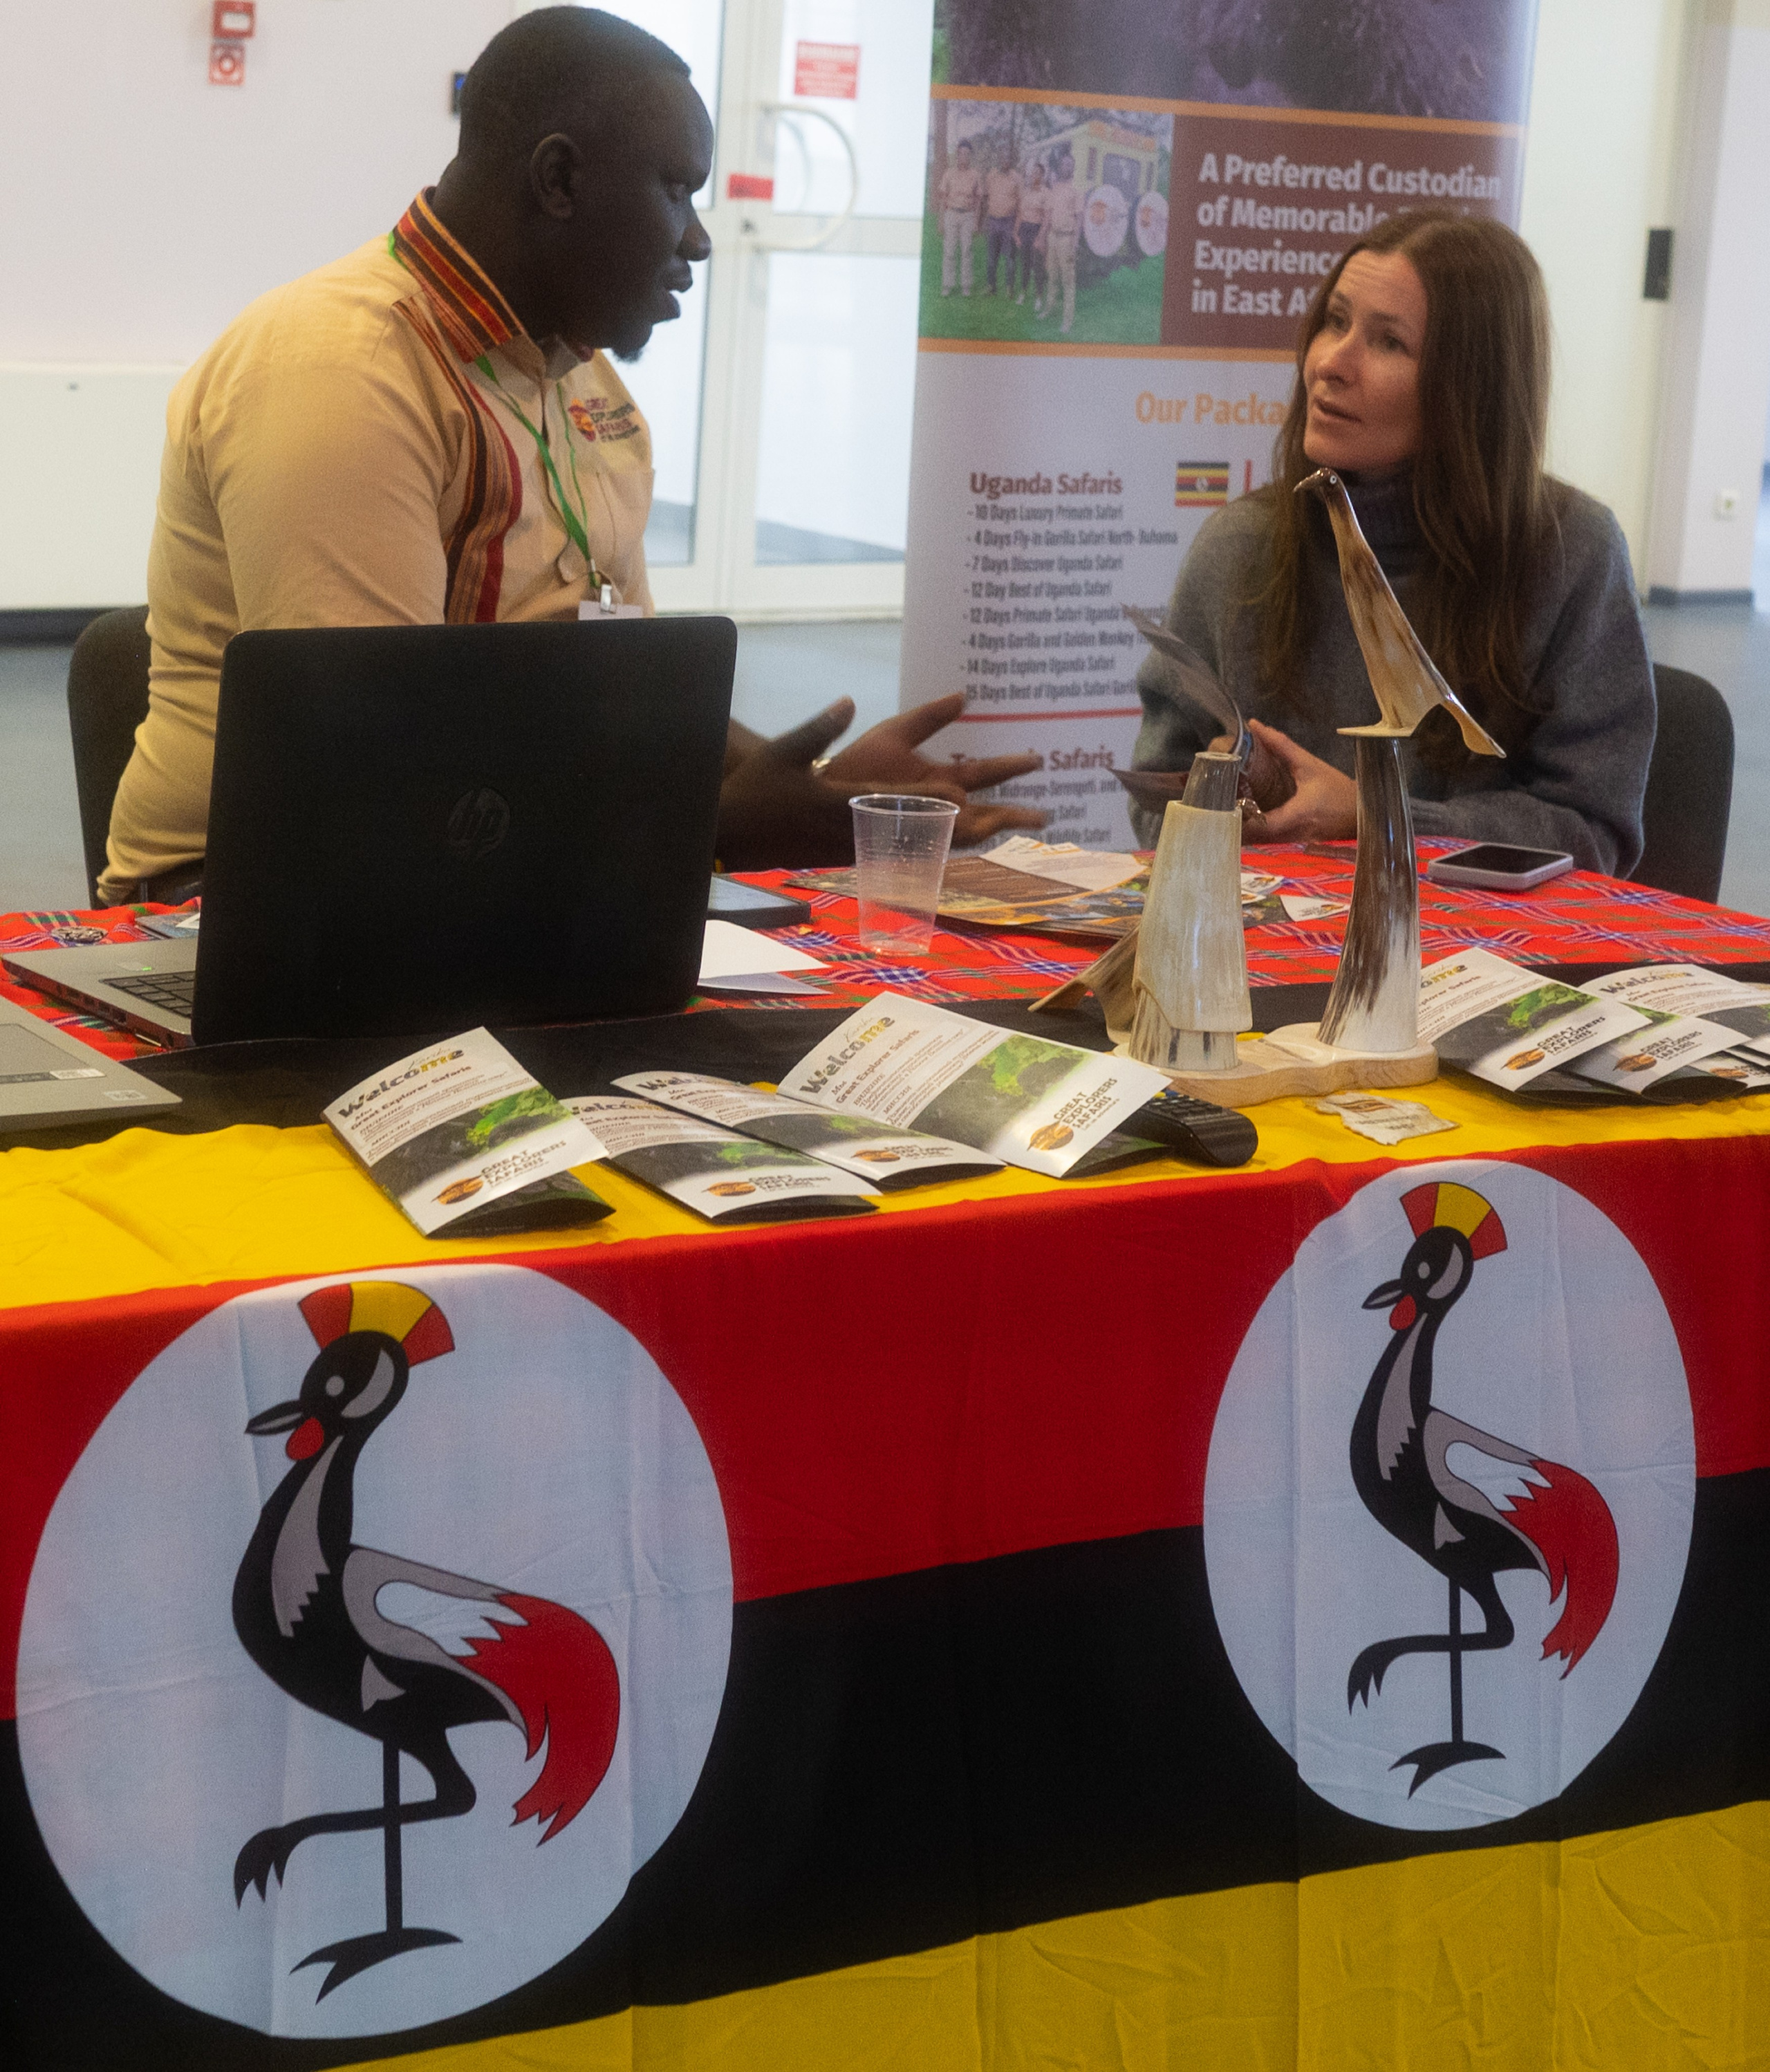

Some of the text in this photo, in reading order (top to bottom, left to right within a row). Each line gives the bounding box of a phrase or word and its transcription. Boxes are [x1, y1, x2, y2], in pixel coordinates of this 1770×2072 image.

[1199, 153, 1500, 198] A Preferred Custodian
[1198, 196, 1229, 227] of
[1191, 278, 1216, 313] in
[1222, 284, 1283, 316] East
[1135, 391, 1290, 426] Our Packa
[970, 472, 1122, 499] Uganda Safaris
[991, 504, 1016, 524] Days
[1096, 504, 1123, 520] Safari
[984, 530, 1011, 549] Days
[1079, 530, 1106, 545] Safari
[982, 556, 1008, 575] Days
[1058, 555, 1092, 575] Uganda
[1095, 555, 1123, 571] Safari
[1009, 582, 1031, 597] Best
[1034, 581, 1043, 597] of
[1045, 582, 1081, 600] Uganda
[1084, 580, 1112, 596] Safari
[984, 608, 1010, 627] Days
[1055, 607, 1082, 622] Safari
[1085, 607, 1119, 625] Uganda
[978, 633, 1005, 651] Days
[1007, 632, 1041, 648] Gorilla
[1043, 633, 1057, 647] and
[1060, 632, 1096, 647] Golden
[1099, 631, 1134, 649] Monkey
[981, 659, 1007, 678] Days
[1010, 659, 1046, 678] Explore
[1049, 658, 1085, 677] Uganda
[1088, 656, 1115, 672] Safari
[980, 684, 1007, 703] Days
[1009, 684, 1031, 699] Best
[1034, 683, 1043, 699] of
[1045, 683, 1081, 701] Uganda
[1084, 681, 1112, 696] Safari
[1050, 743, 1114, 771] Safaris
[799, 1017, 895, 1093] Welcome
[836, 1081, 859, 1104] Great
[856, 1051, 891, 1082] Explorer
[889, 1029, 920, 1051] Safaris
[338, 1049, 464, 1118] Welcome
[351, 1110, 380, 1130] Great
[382, 1083, 428, 1110] Explorer
[431, 1066, 472, 1084] Safaris
[1054, 1091, 1088, 1120] GREAT
[1063, 1077, 1118, 1124] EXPLORERS
[1072, 1095, 1112, 1129] SAFARIS
[481, 1149, 528, 1174] GREAT
[484, 1140, 567, 1178] EXPLORERS
[487, 1157, 544, 1185] SAFARIS
